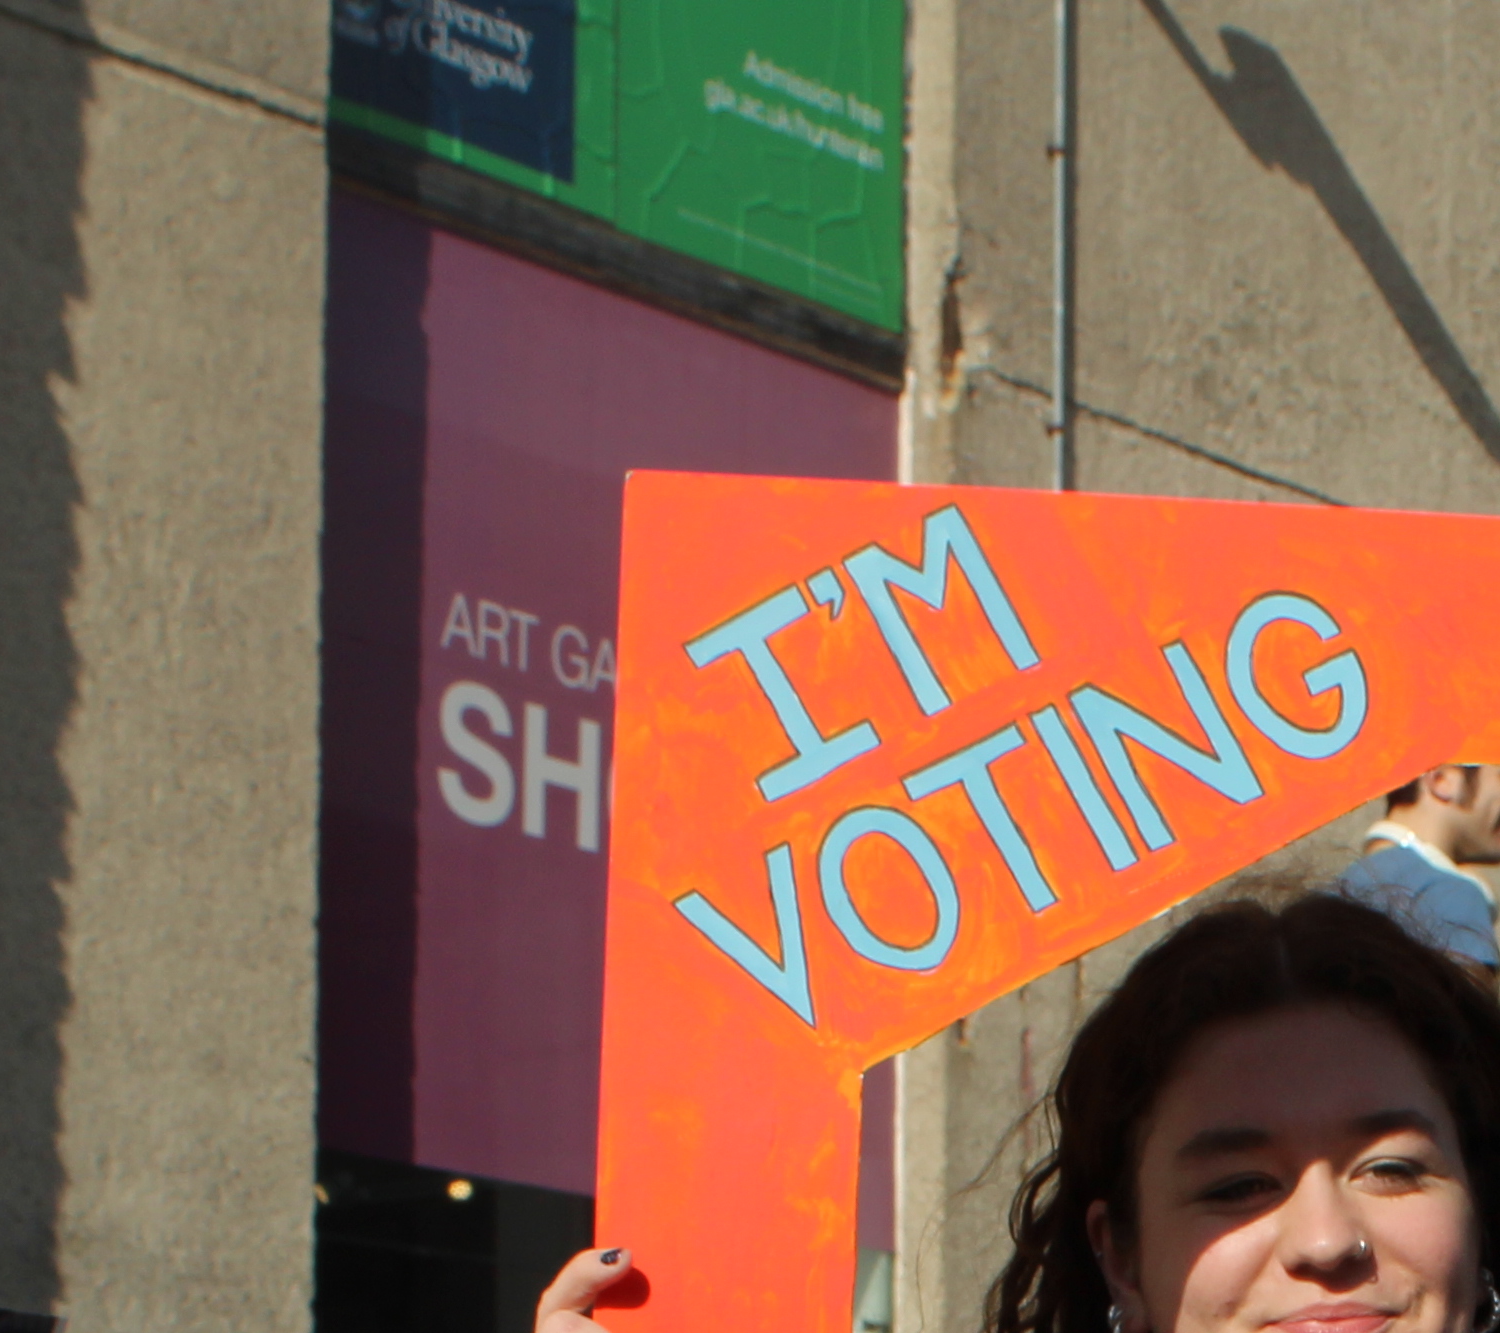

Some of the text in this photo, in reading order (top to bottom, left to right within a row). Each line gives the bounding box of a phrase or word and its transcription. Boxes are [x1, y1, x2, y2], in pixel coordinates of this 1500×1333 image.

[440, 592, 540, 672] ART
[684, 503, 1041, 803] I'M
[672, 591, 1369, 1030] VOTING
